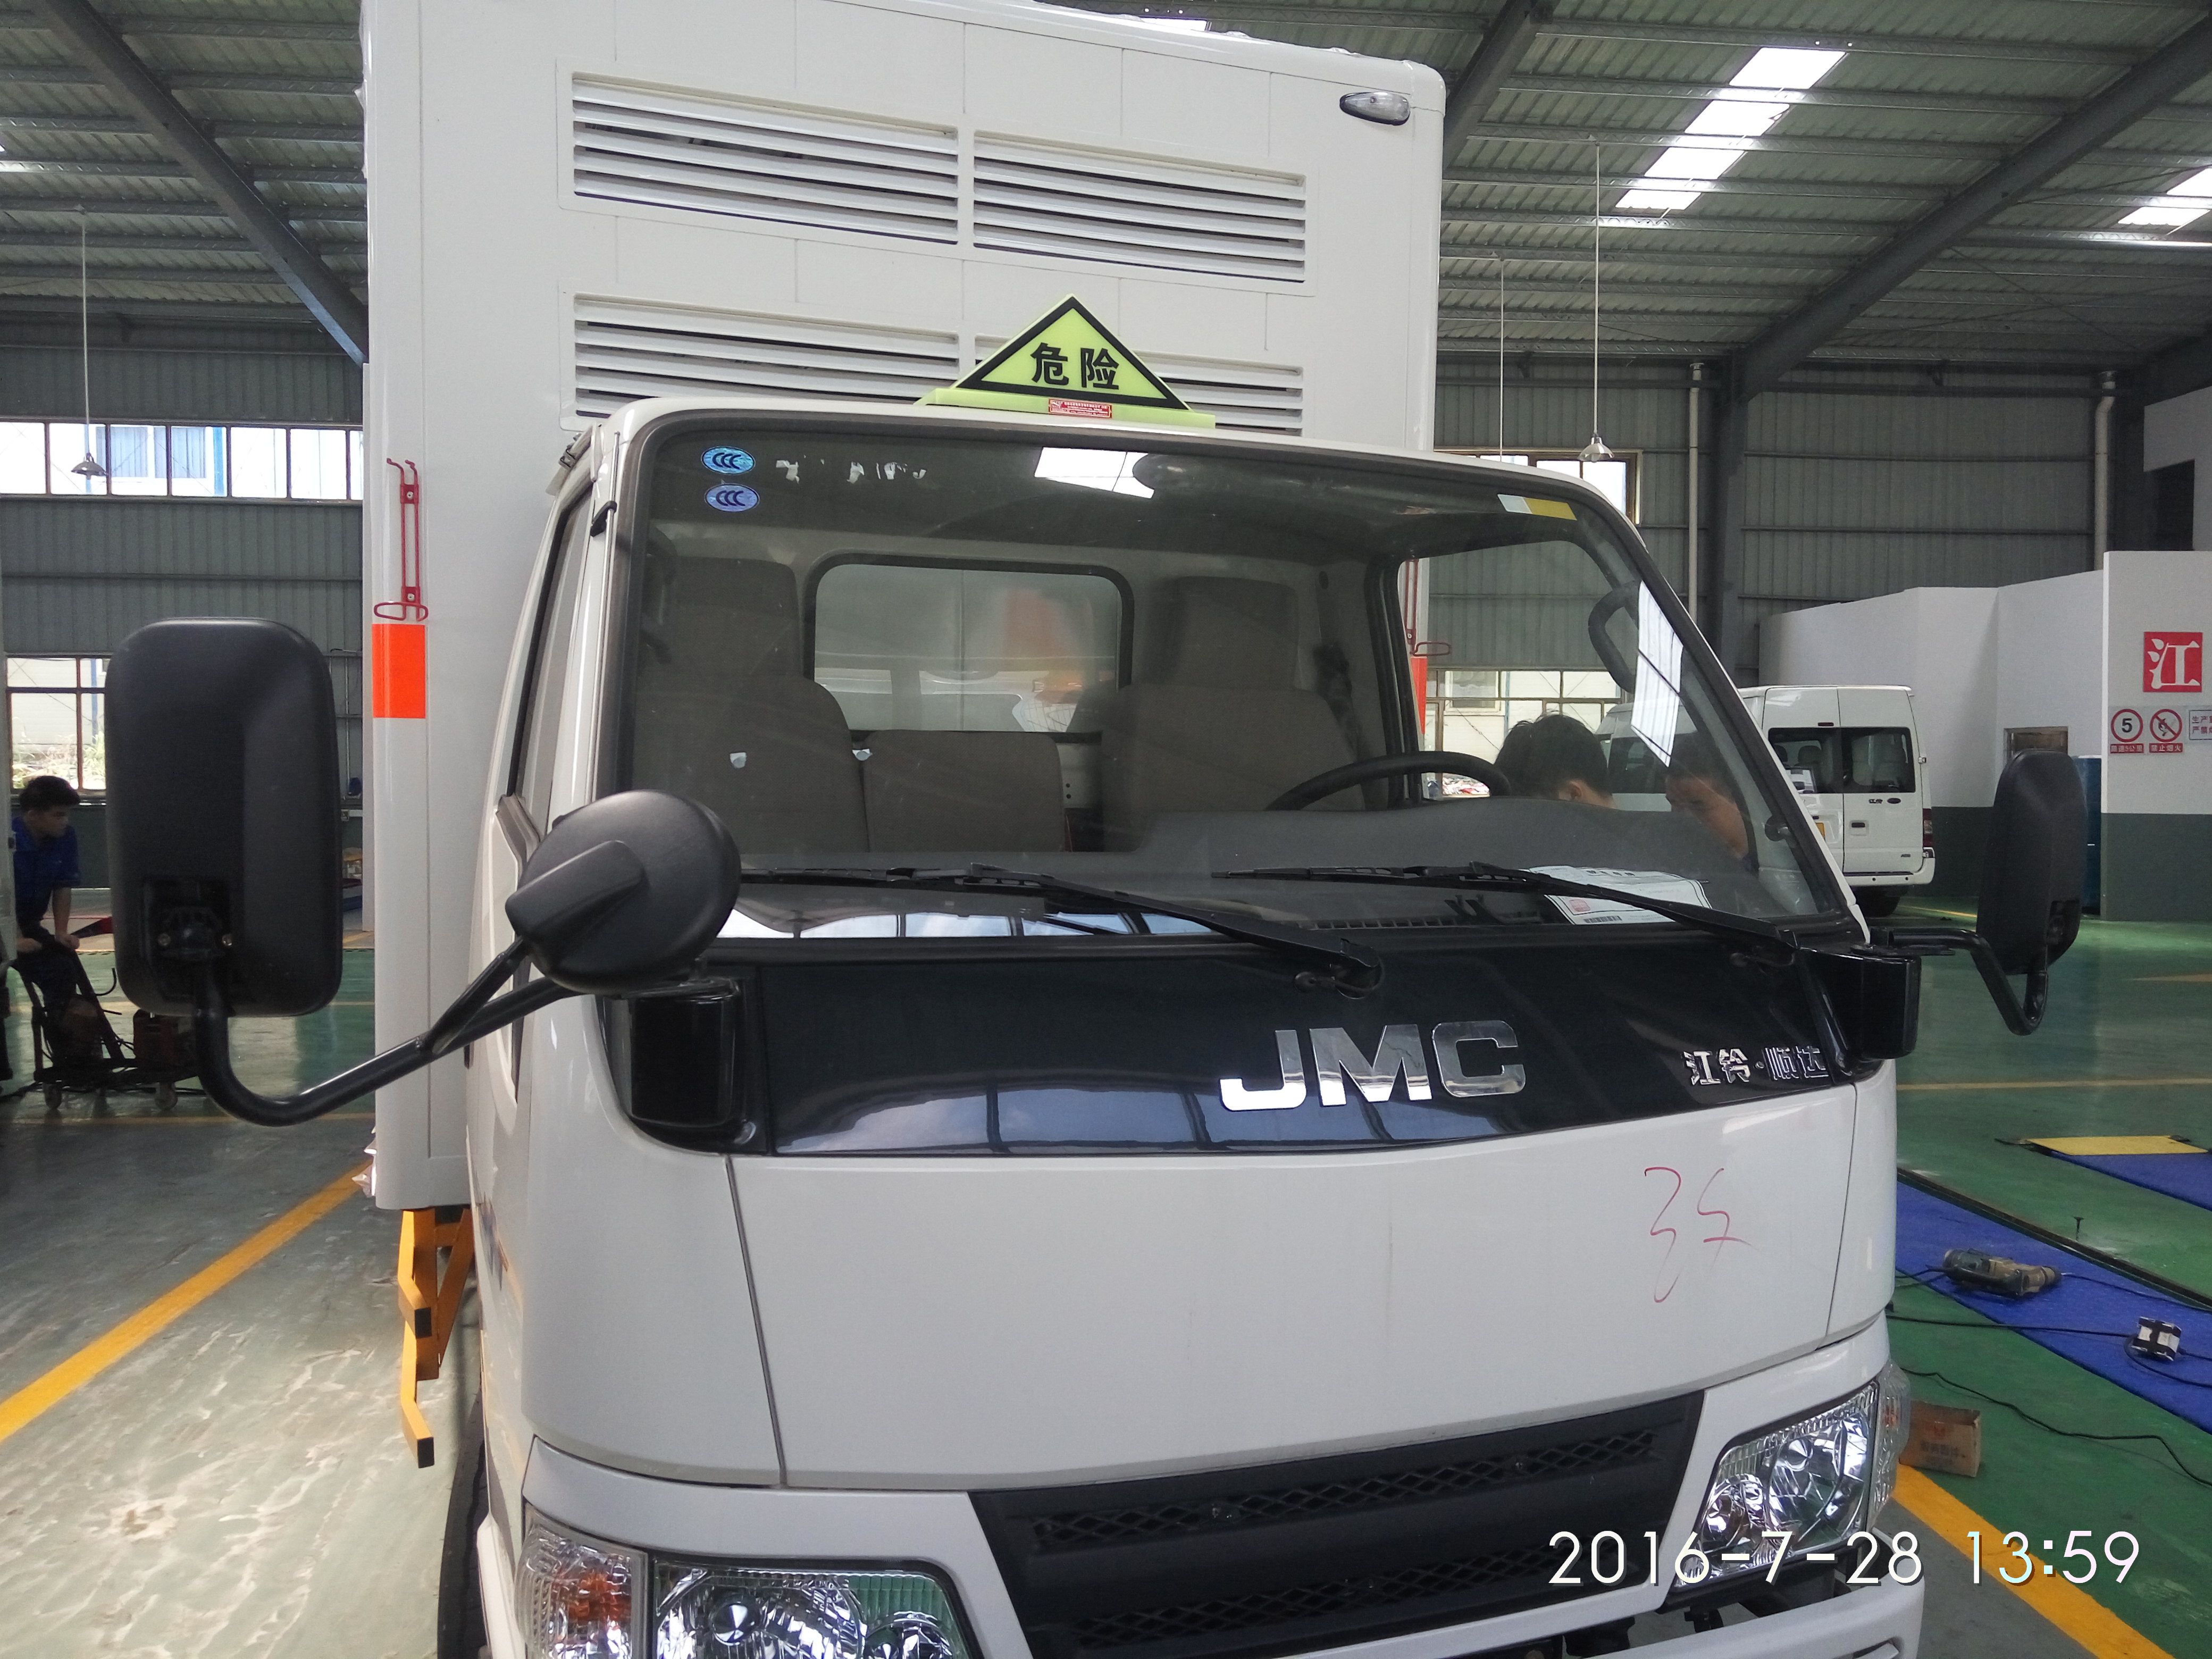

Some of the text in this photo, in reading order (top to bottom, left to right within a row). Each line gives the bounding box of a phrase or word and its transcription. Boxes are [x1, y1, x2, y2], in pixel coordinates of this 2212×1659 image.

[1030, 342, 1120, 390] 危险
[712, 452, 742, 470] CCC
[715, 490, 745, 507] CCC
[2148, 639, 2201, 689] 江
[2122, 718, 2132, 733] 5
[1219, 1019, 1526, 1112] JMC
